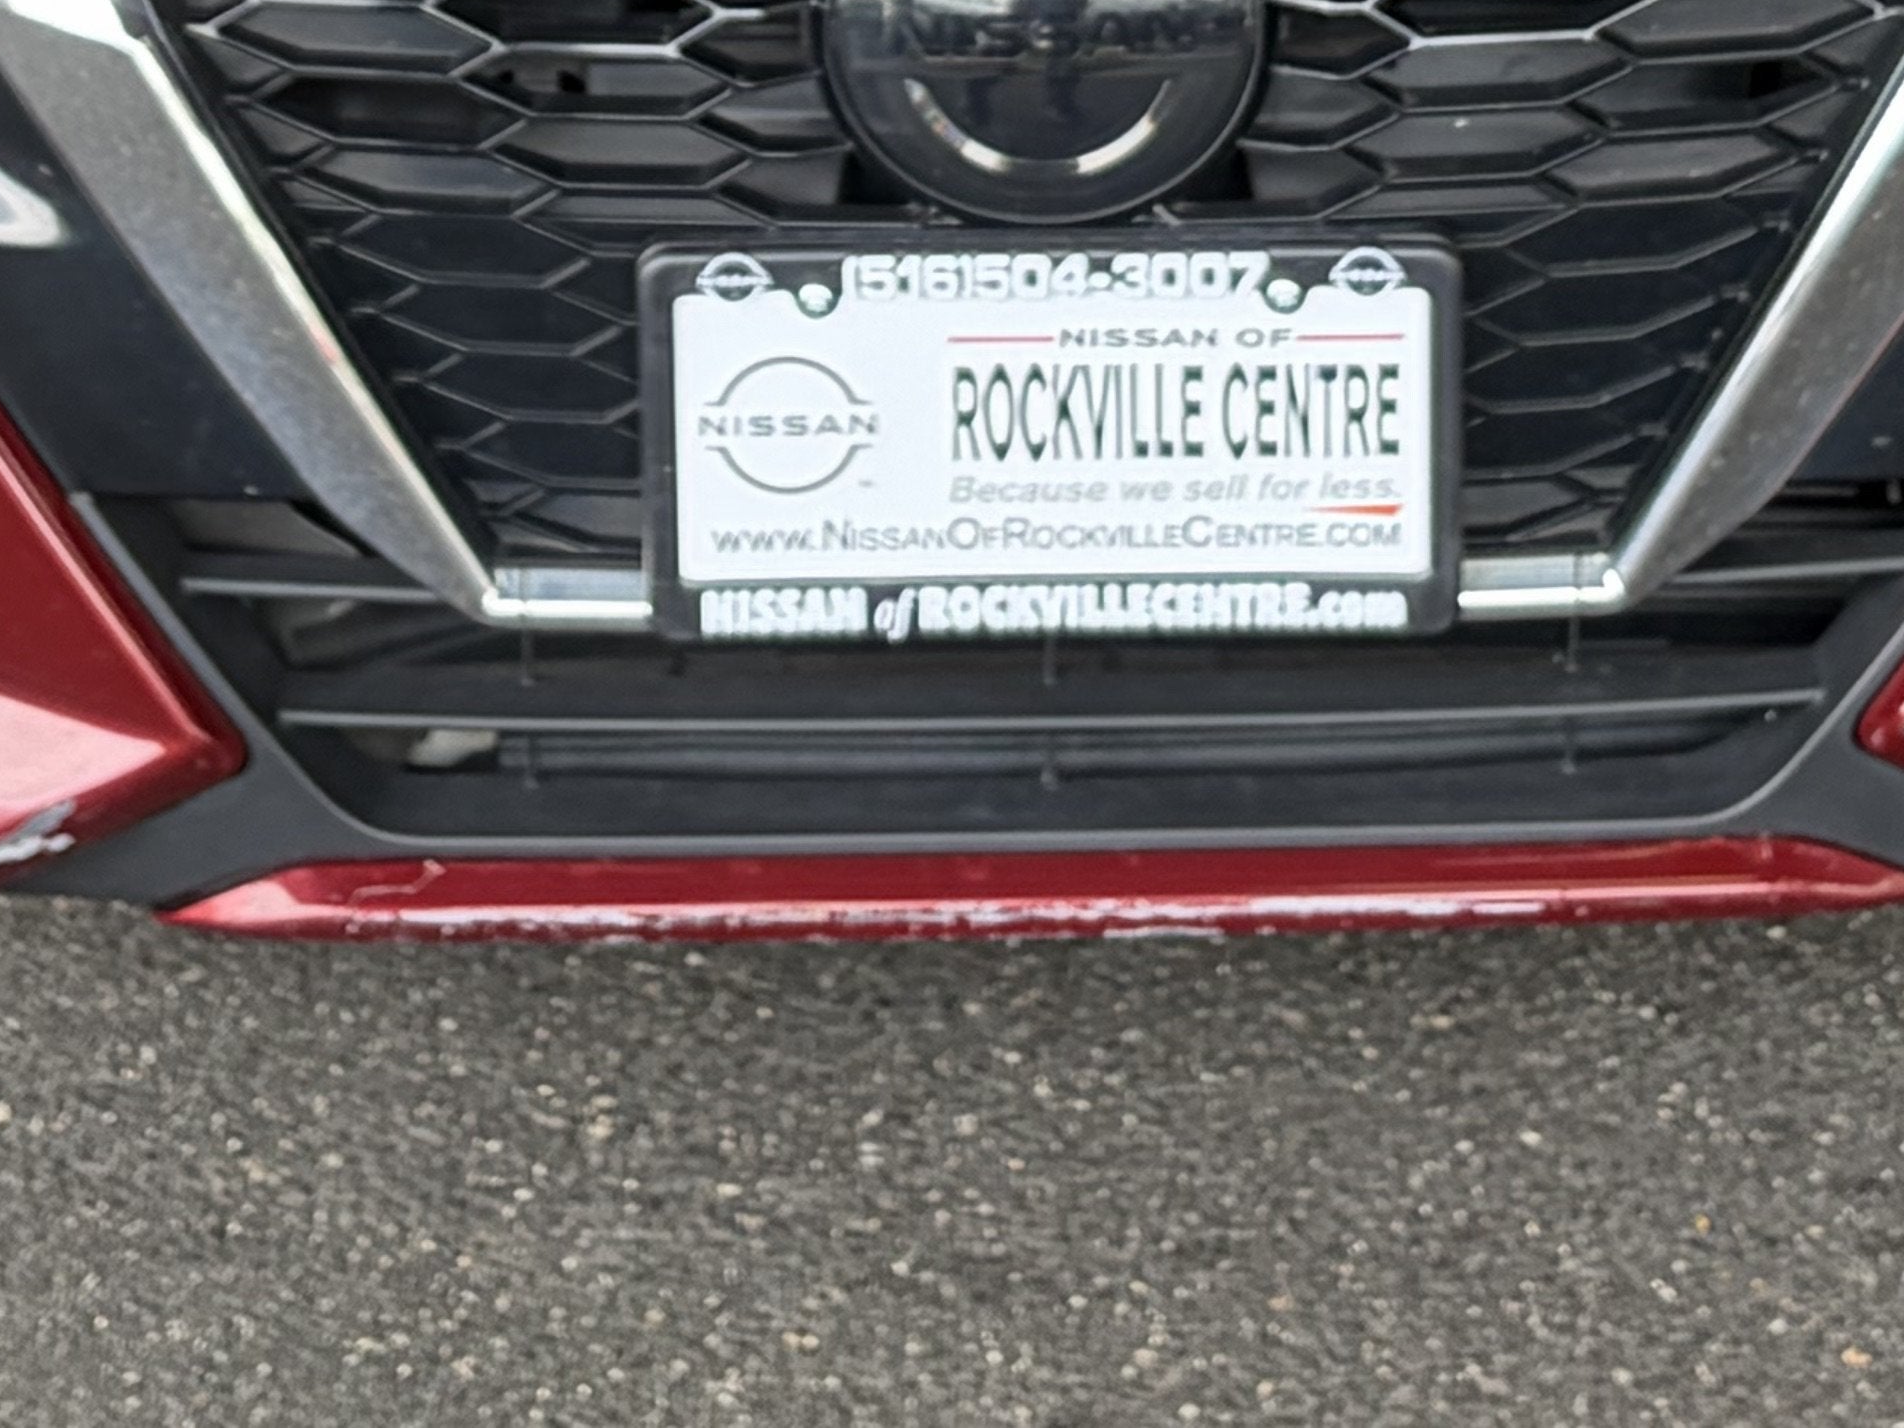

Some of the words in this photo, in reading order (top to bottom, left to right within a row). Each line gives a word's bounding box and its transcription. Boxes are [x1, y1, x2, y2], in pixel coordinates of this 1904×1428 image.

[1059, 328, 1218, 347] NISSAN
[1235, 328, 1293, 347] OF
[698, 414, 879, 437] NISSAN
[951, 362, 1204, 462] ROCKVILLE
[1221, 362, 1400, 460] CENTRE
[948, 476, 1109, 504] Because
[1120, 481, 1173, 502] we
[1184, 474, 1248, 502] sell
[1256, 473, 1309, 501] for
[700, 585, 867, 636] NISSAN
[873, 586, 918, 644] of
